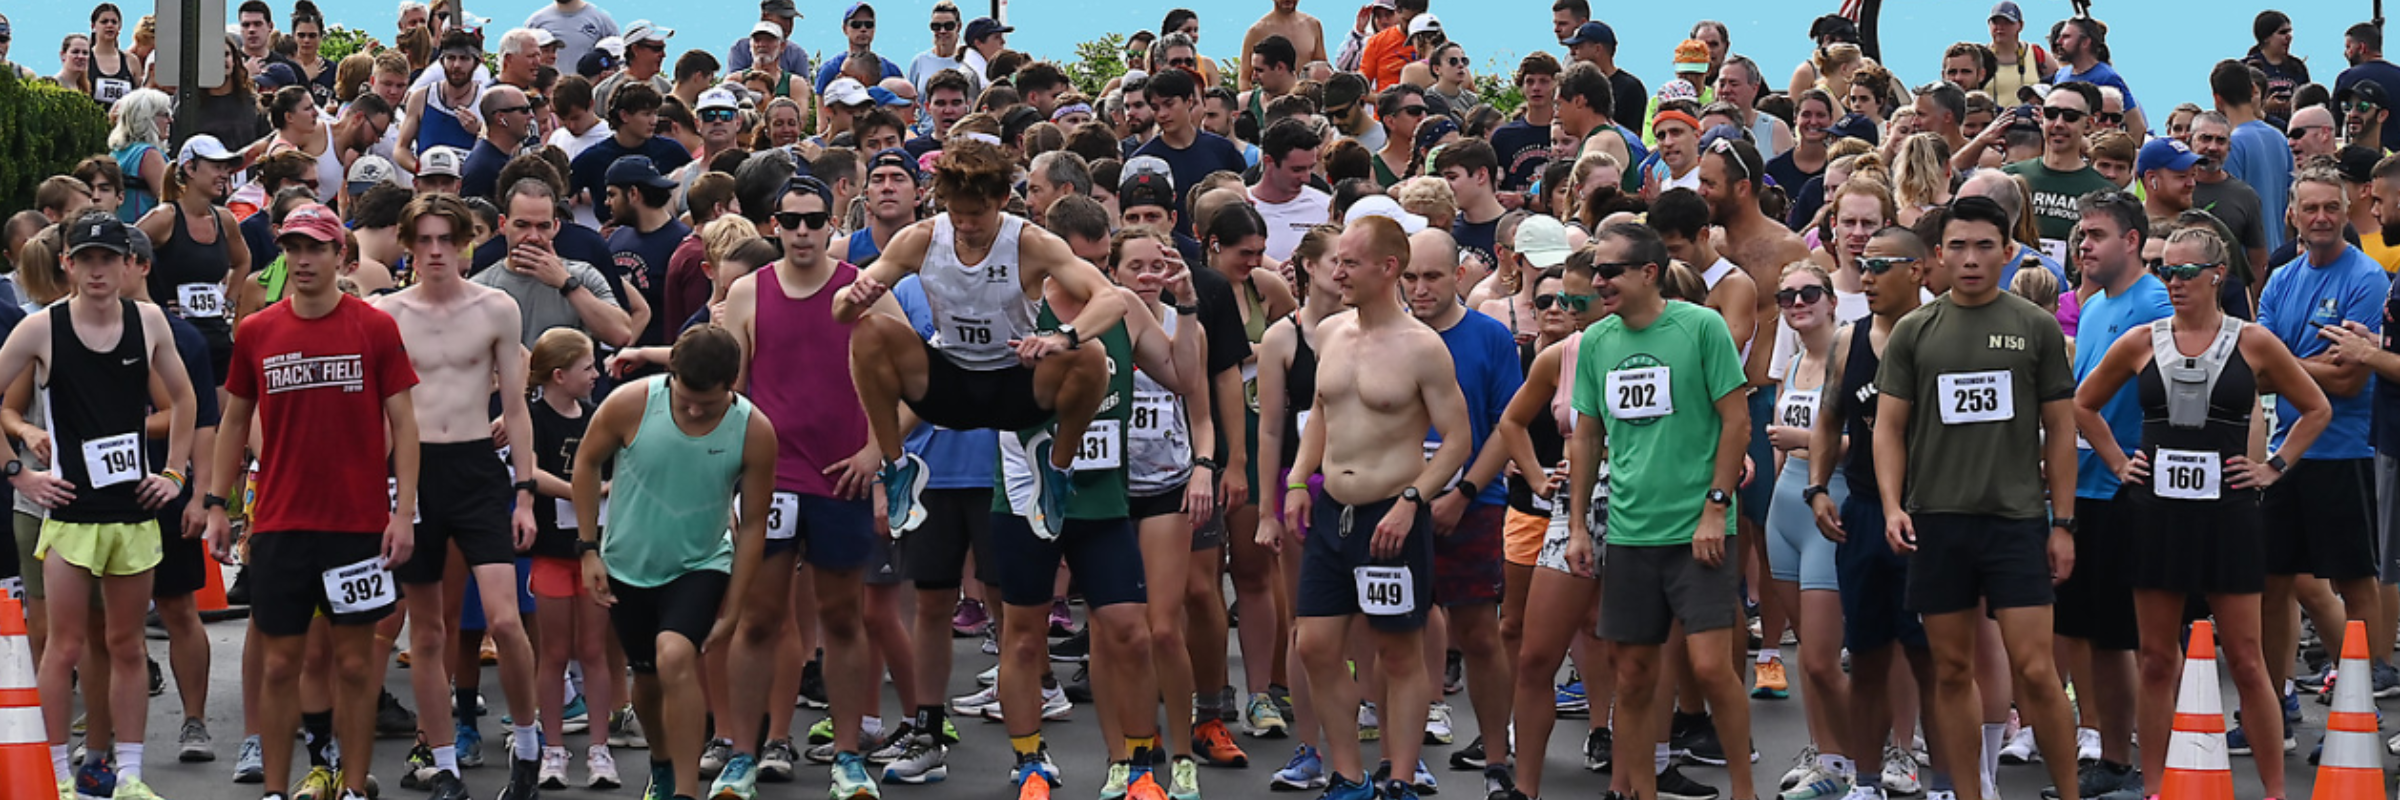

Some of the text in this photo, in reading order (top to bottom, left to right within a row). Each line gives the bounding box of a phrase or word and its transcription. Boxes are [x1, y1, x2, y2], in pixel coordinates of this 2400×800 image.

[190, 293, 216, 311] 435
[955, 325, 992, 344] 179
[264, 360, 363, 389] TRACK FIELD
[1619, 383, 1656, 409] 202
[1954, 388, 1998, 413] 253
[1129, 406, 1158, 429] 81
[1783, 404, 1811, 428] 439
[101, 449, 136, 474] 194
[2167, 466, 2205, 491] 160
[341, 573, 385, 605] 392
[1367, 582, 1402, 606] 449
